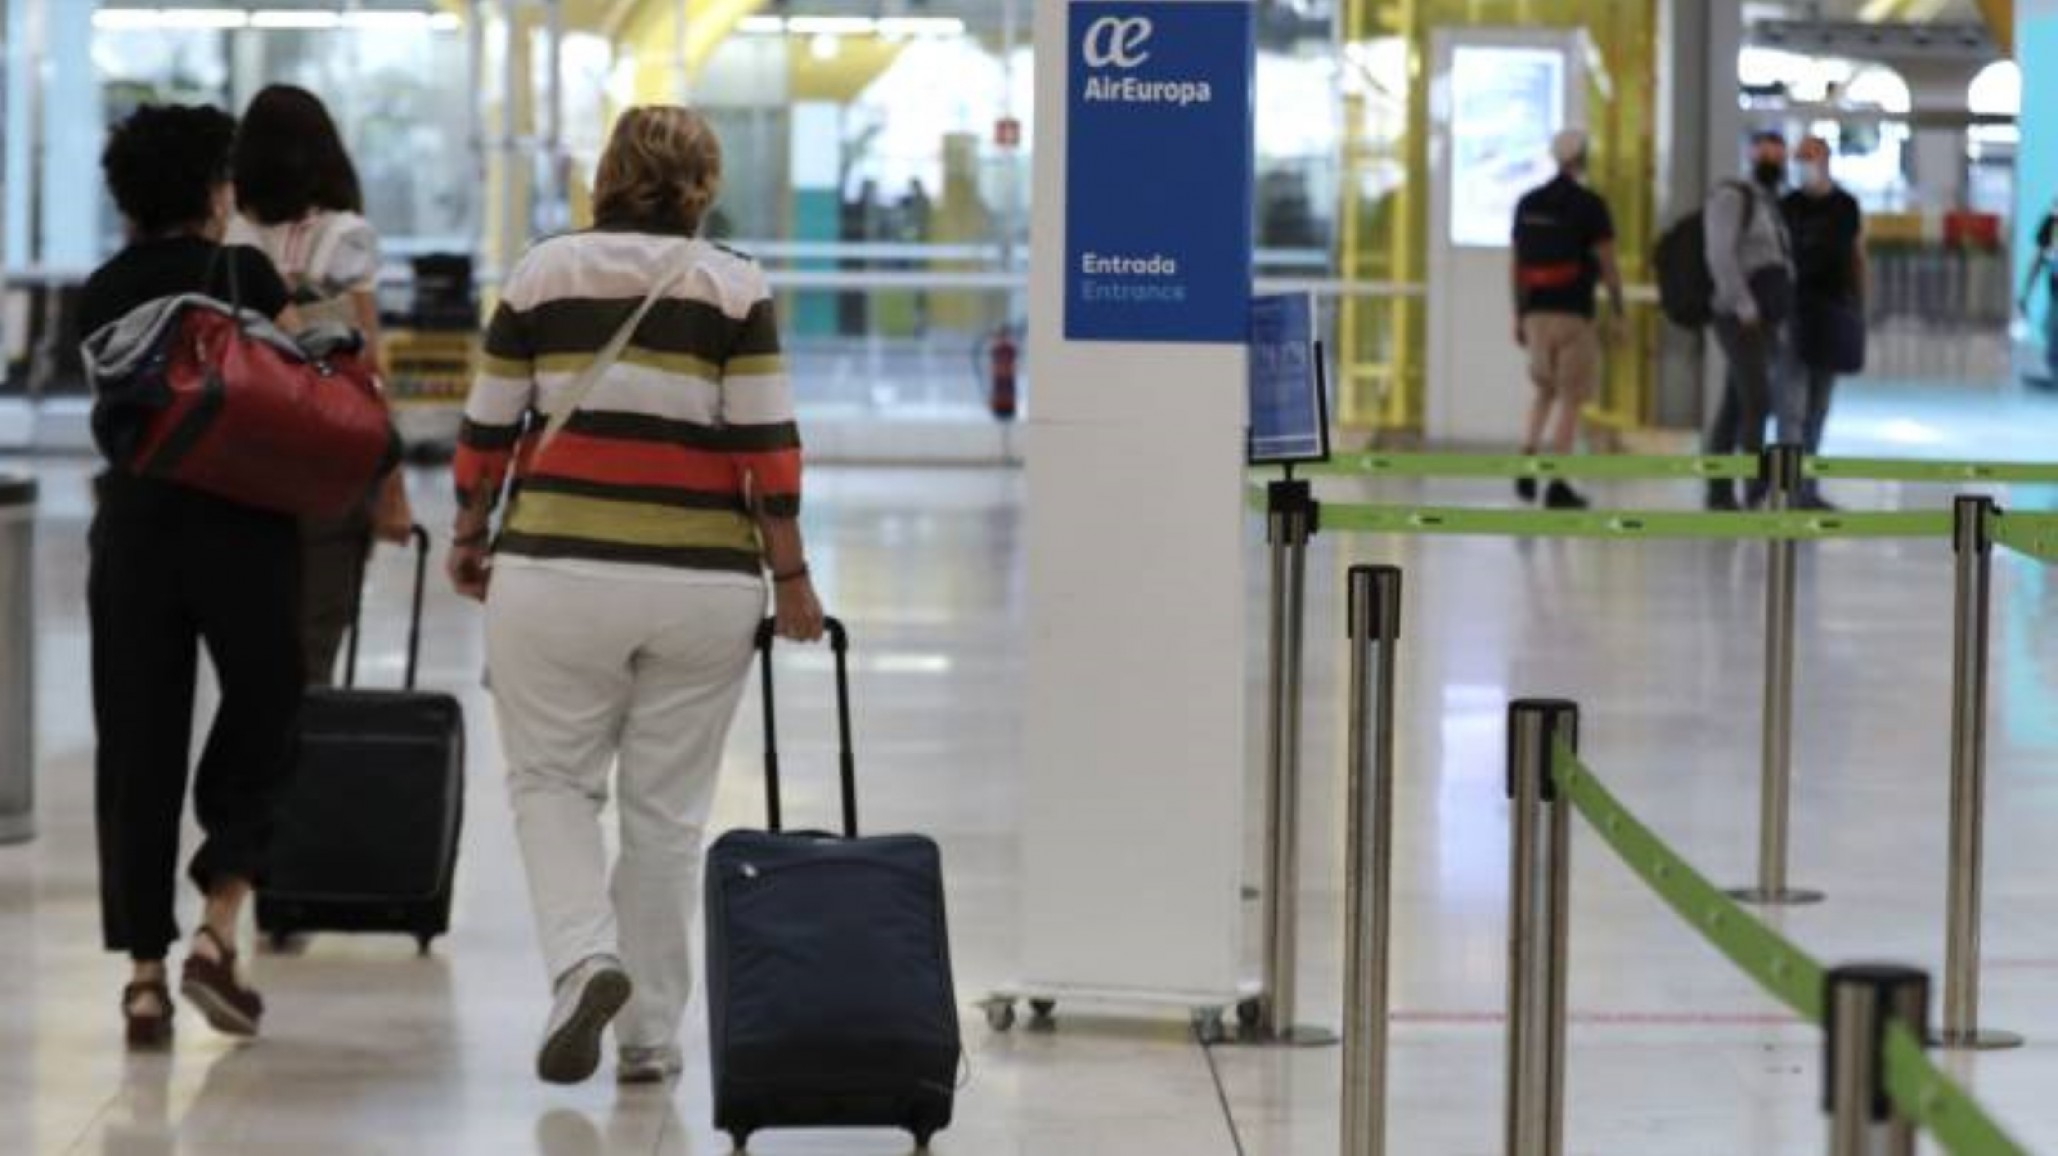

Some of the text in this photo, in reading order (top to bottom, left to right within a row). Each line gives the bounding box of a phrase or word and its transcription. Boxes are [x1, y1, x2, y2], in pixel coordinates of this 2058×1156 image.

[1084, 76, 1211, 106] AirEuropa
[1082, 252, 1175, 274] Entrada
[1082, 280, 1186, 300] Entrance
